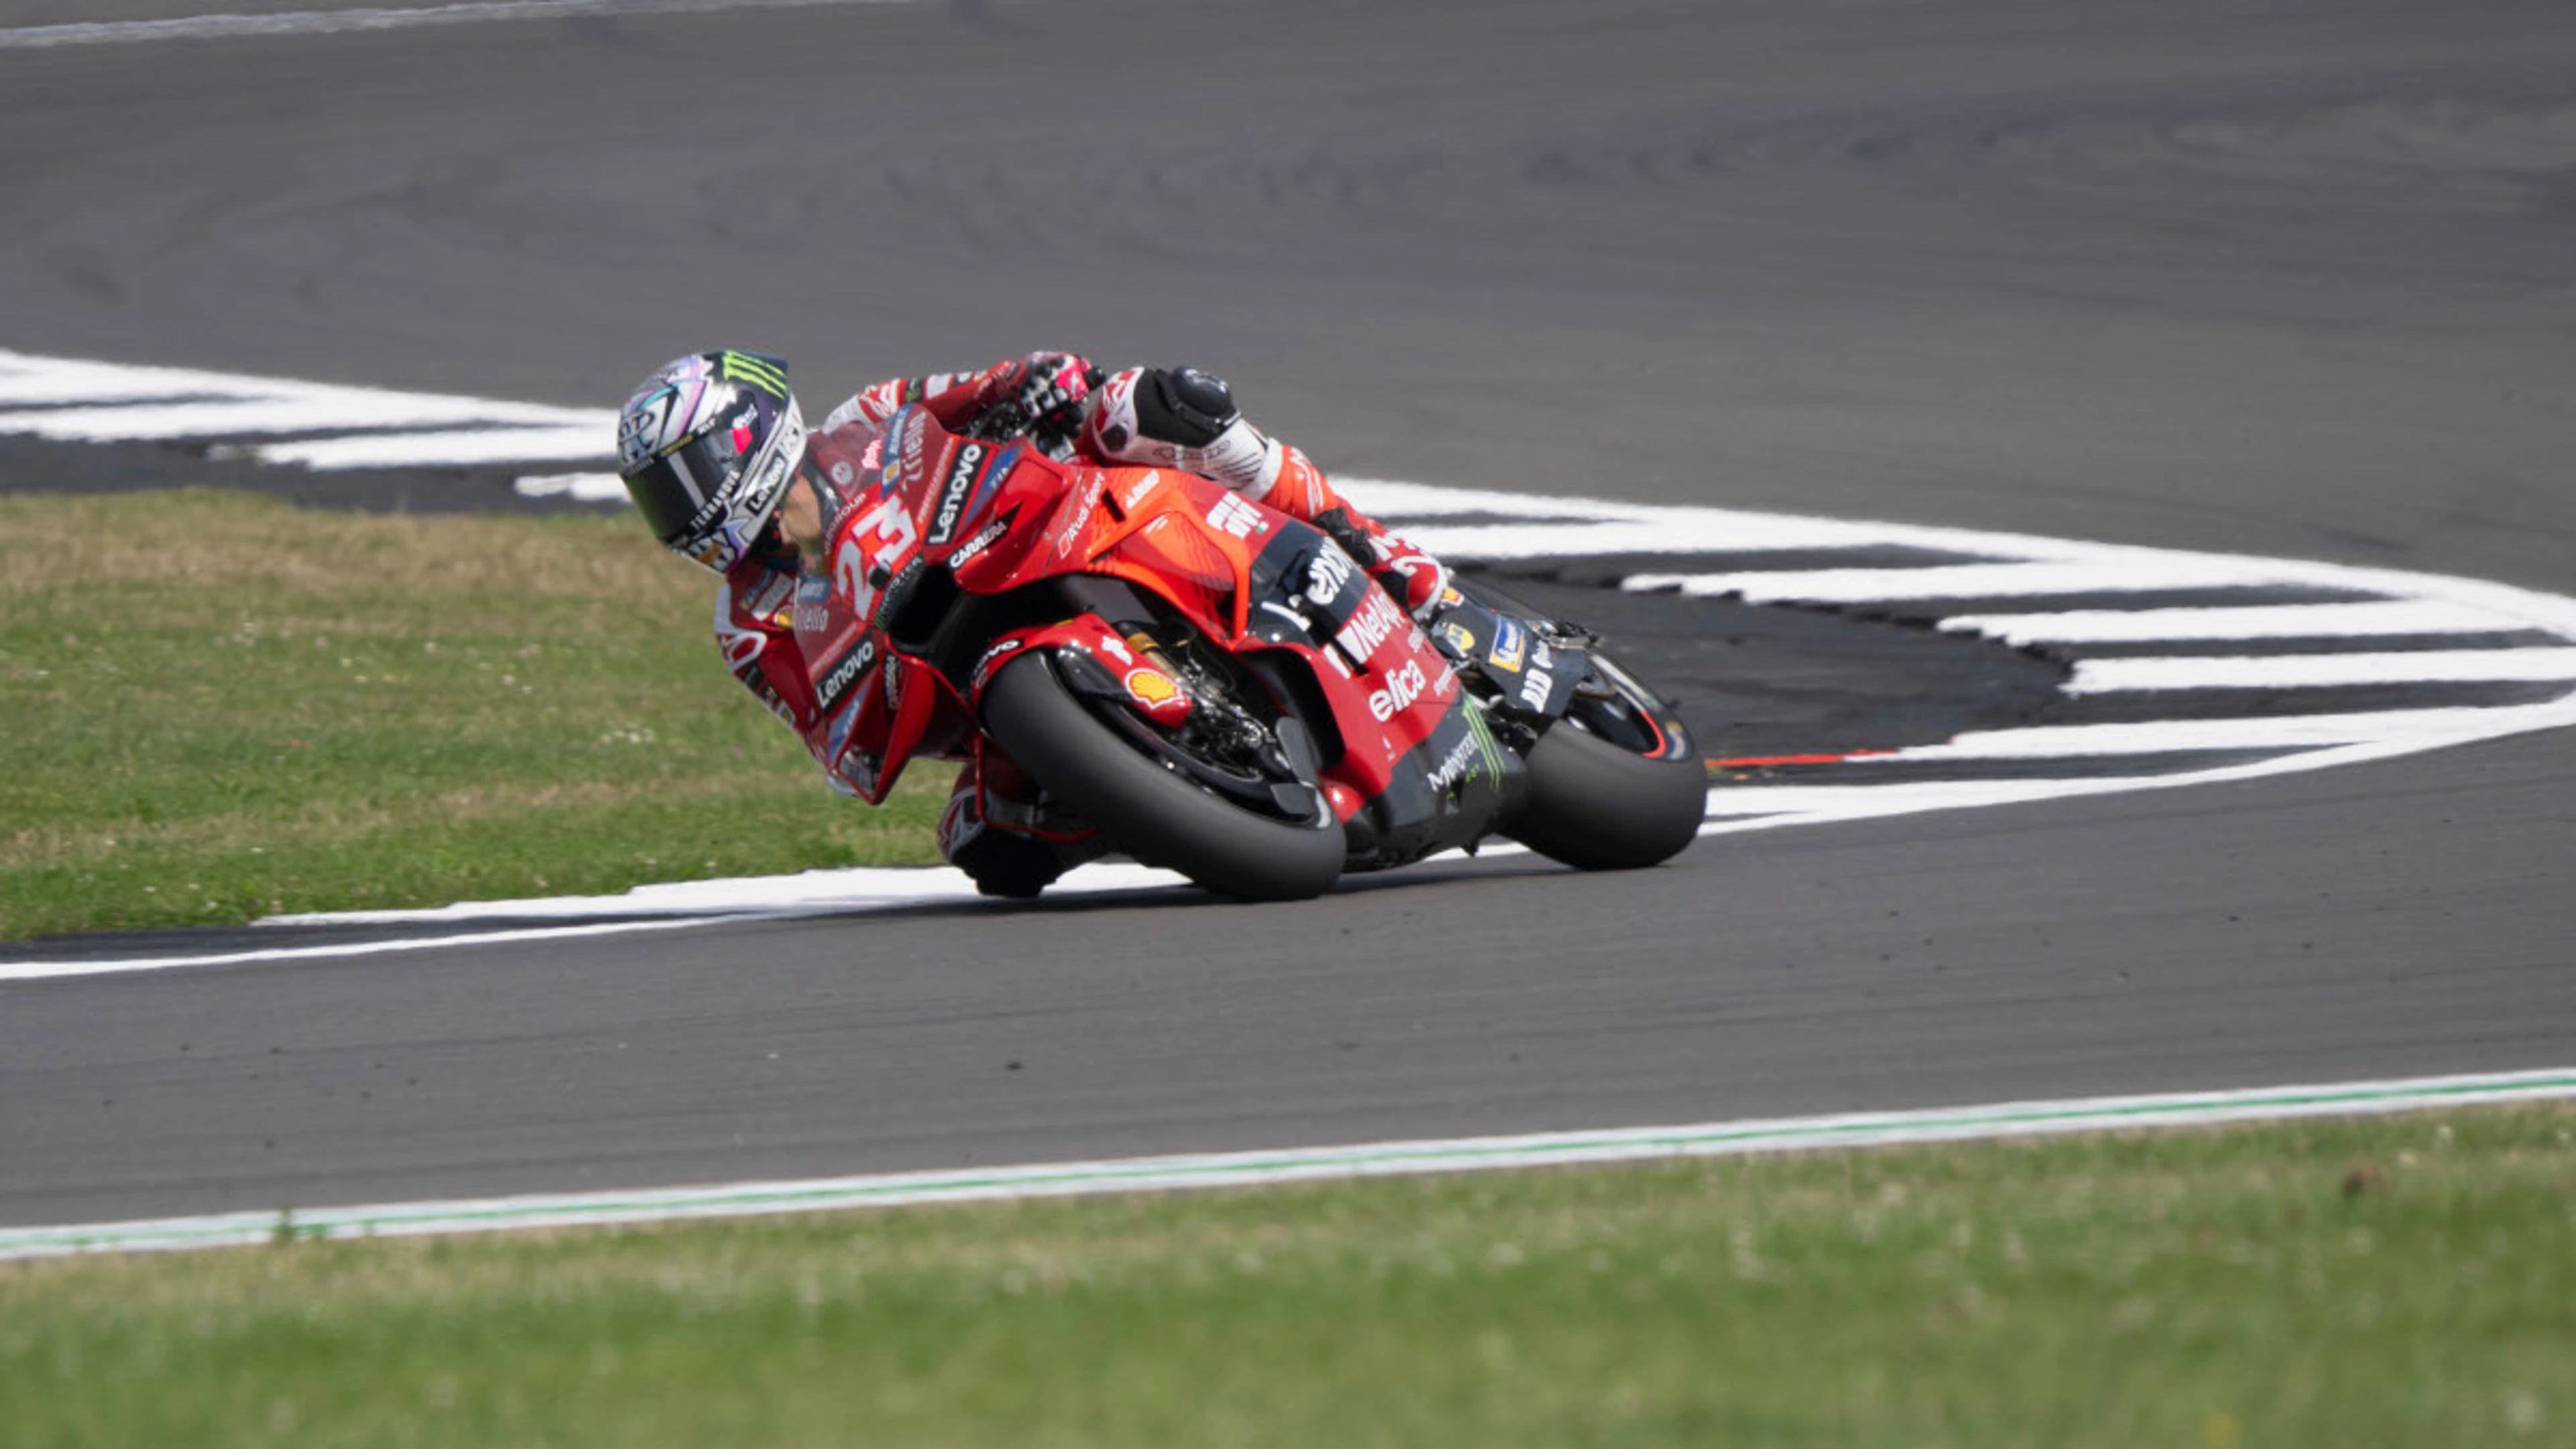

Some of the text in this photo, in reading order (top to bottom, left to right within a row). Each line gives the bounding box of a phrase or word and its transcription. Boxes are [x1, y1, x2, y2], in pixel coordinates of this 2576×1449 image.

[749, 456, 786, 511] Lenovo
[928, 443, 982, 545] Lenovo
[838, 495, 917, 621] 23
[949, 521, 1007, 568] CARRERA
[816, 641, 874, 709] Lenovo
[1368, 659, 1426, 722] elica
